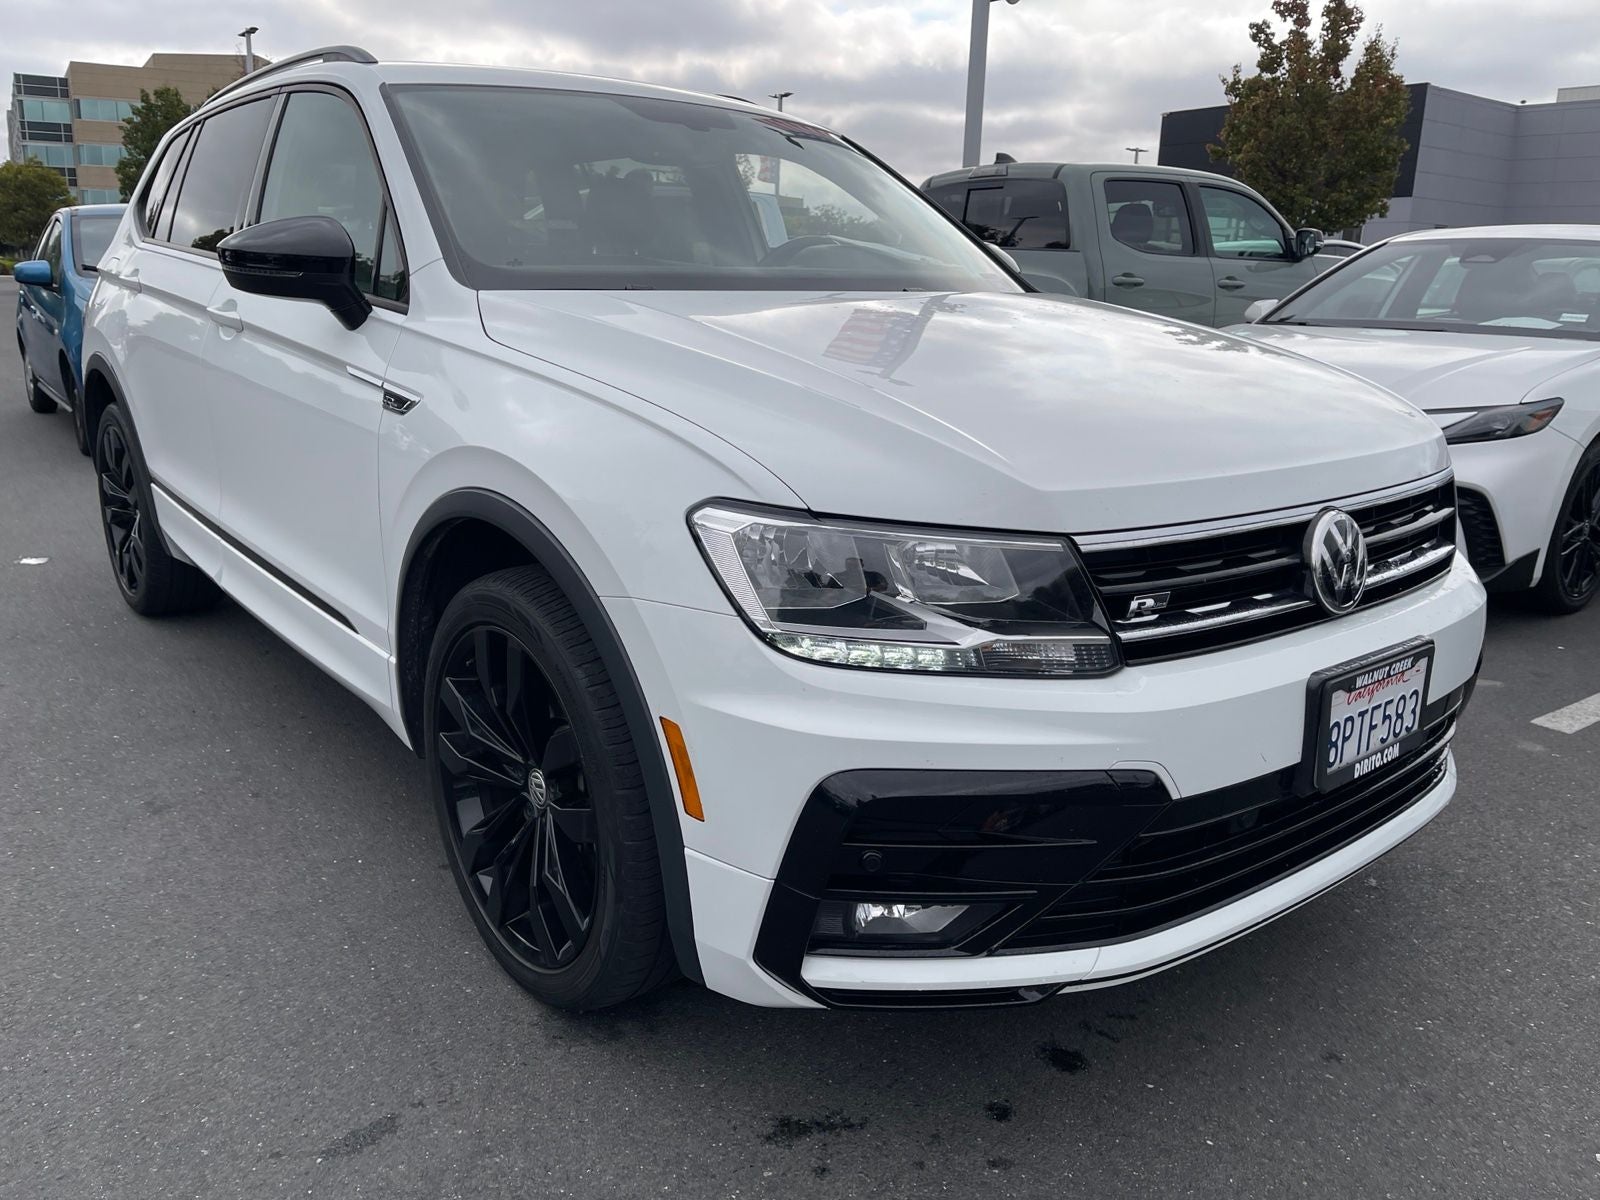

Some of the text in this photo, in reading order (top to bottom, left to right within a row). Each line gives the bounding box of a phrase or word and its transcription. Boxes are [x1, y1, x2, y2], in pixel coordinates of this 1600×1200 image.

[1355, 657, 1414, 688] WALNUT CREEK
[1327, 689, 1419, 768] 8PTF583
[1354, 742, 1399, 778] DIRITO.COM
